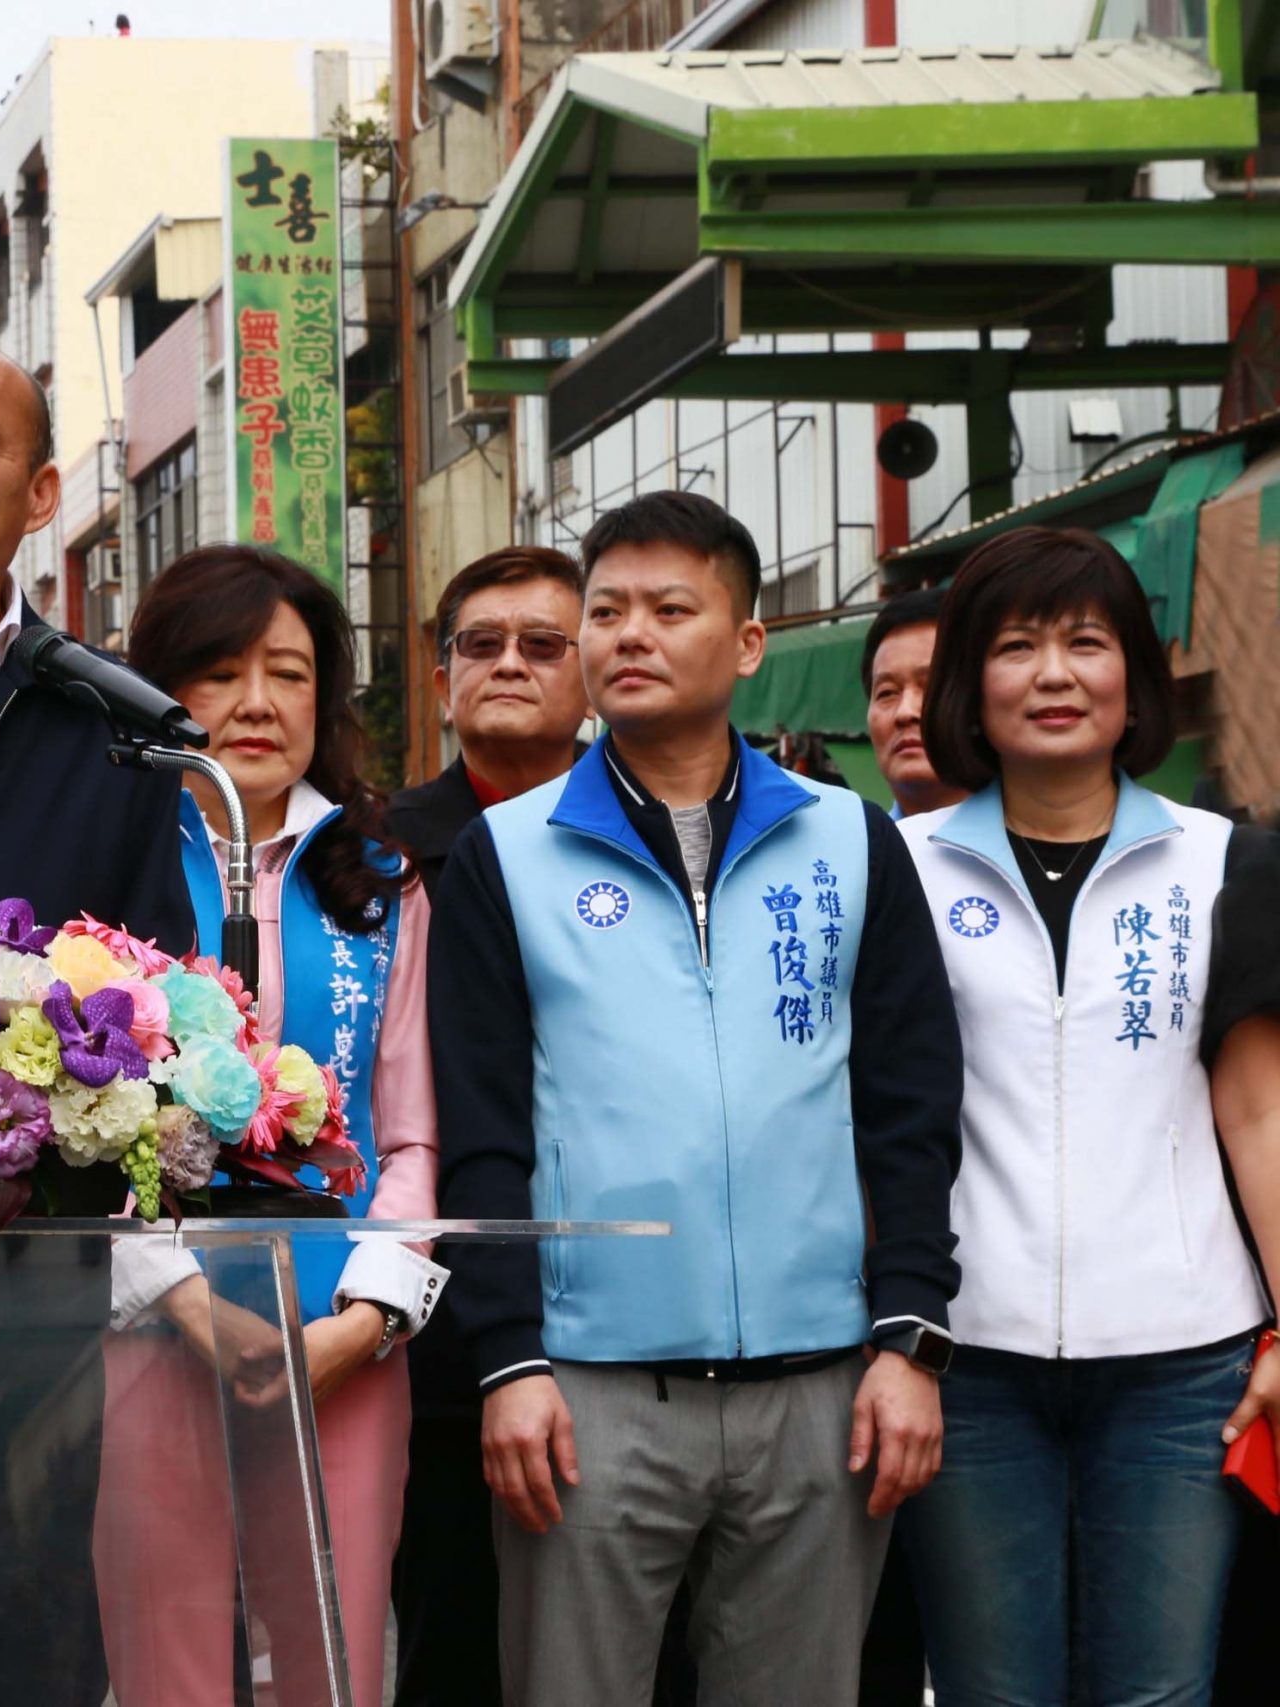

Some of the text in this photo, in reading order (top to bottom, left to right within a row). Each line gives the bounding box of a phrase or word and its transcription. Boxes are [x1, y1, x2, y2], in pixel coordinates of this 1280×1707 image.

[762, 884, 816, 1045] 曾俊傑
[812, 859, 845, 1025] 高雄市議員
[1113, 903, 1163, 1051] 陳若翠
[1168, 884, 1193, 1032] 高雄市議員
